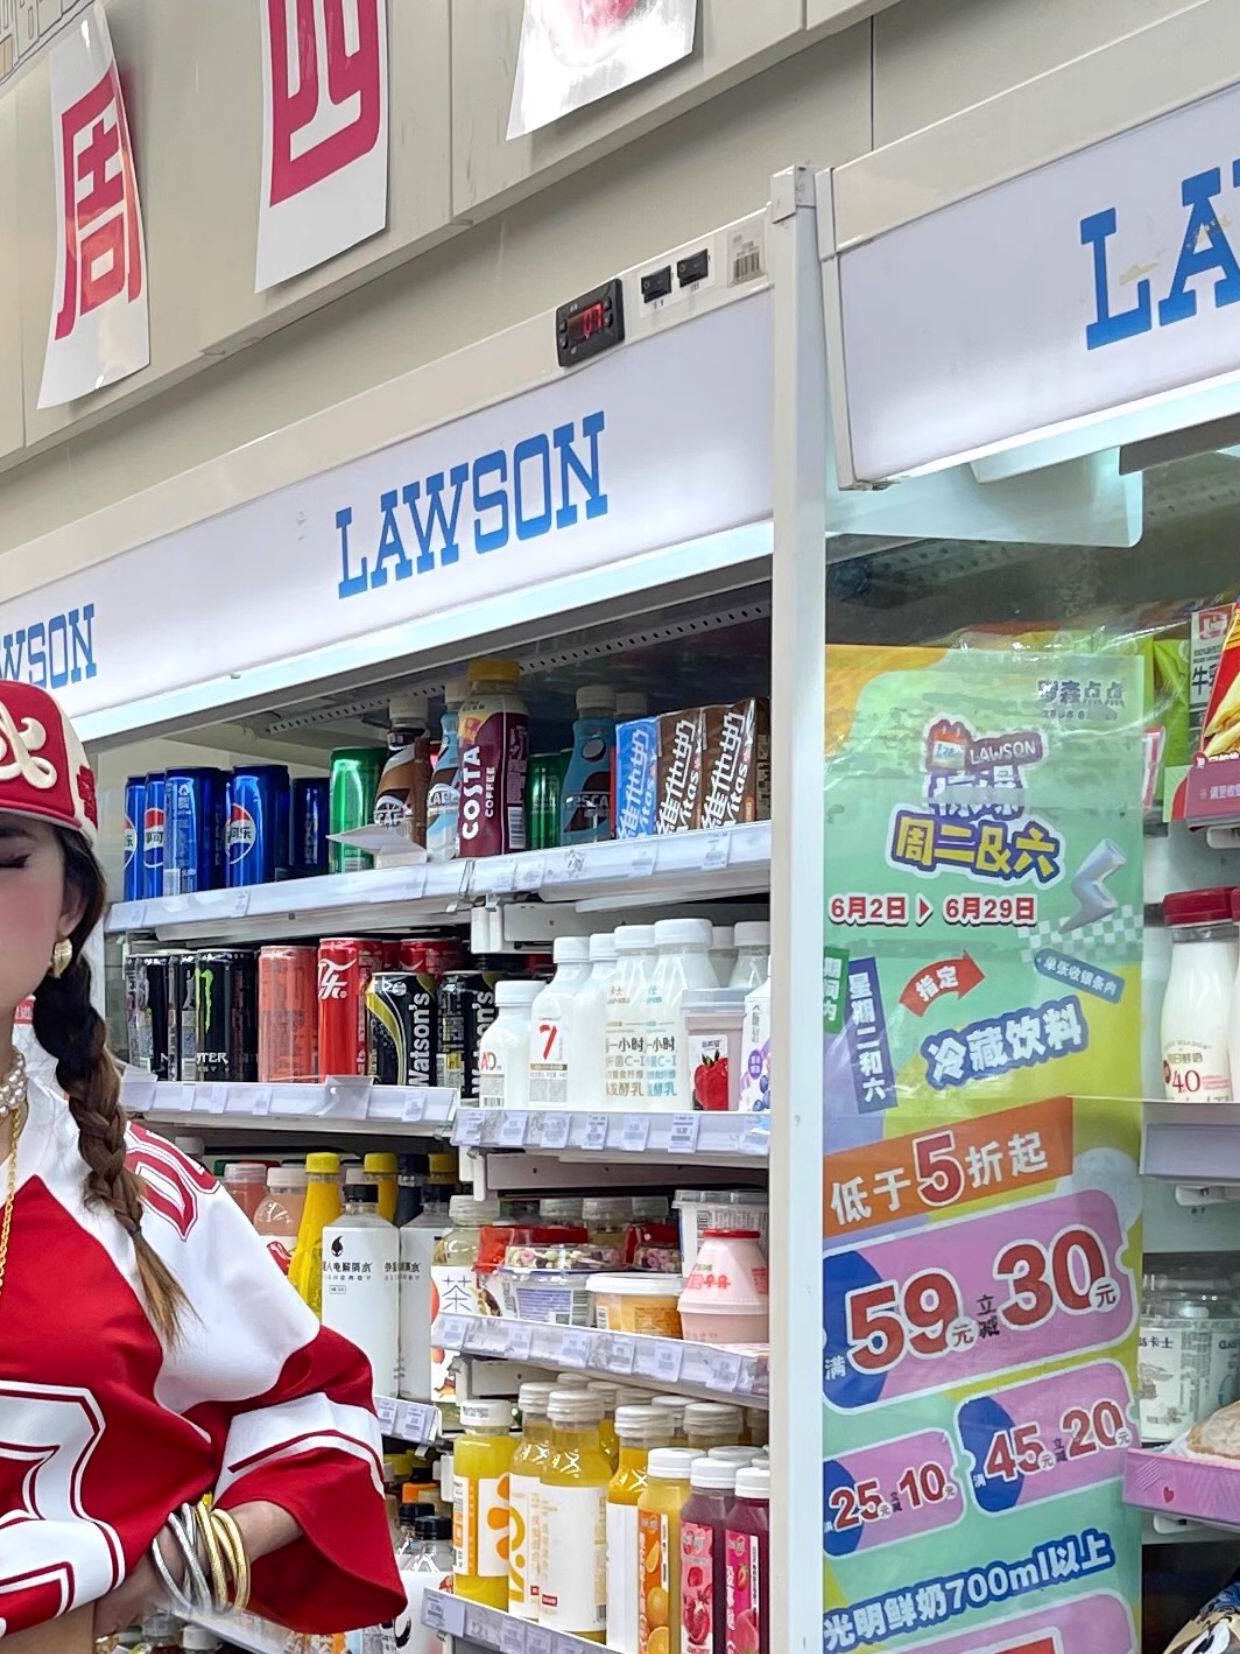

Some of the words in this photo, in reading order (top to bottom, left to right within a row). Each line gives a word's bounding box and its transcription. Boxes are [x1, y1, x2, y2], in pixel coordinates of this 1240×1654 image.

[54, 60, 142, 341] 周
[1080, 155, 1240, 351] LA
[336, 411, 609, 600] LAWSON
[462, 746, 482, 840] COSTA
[485, 767, 495, 818] COFFEE
[970, 740, 1037, 765] LAWSON
[830, 897, 906, 920] 6月2日
[945, 897, 1035, 921] 6月29日
[915, 965, 959, 1001] 指定
[849, 972, 886, 1102] 星期二和六
[928, 1004, 1083, 1082] 冷藏饮料
[831, 1129, 1048, 1225] 低于5折起
[442, 1275, 472, 1313] 茶
[825, 1534, 1111, 1650] 光明鲜奶700ml以上
